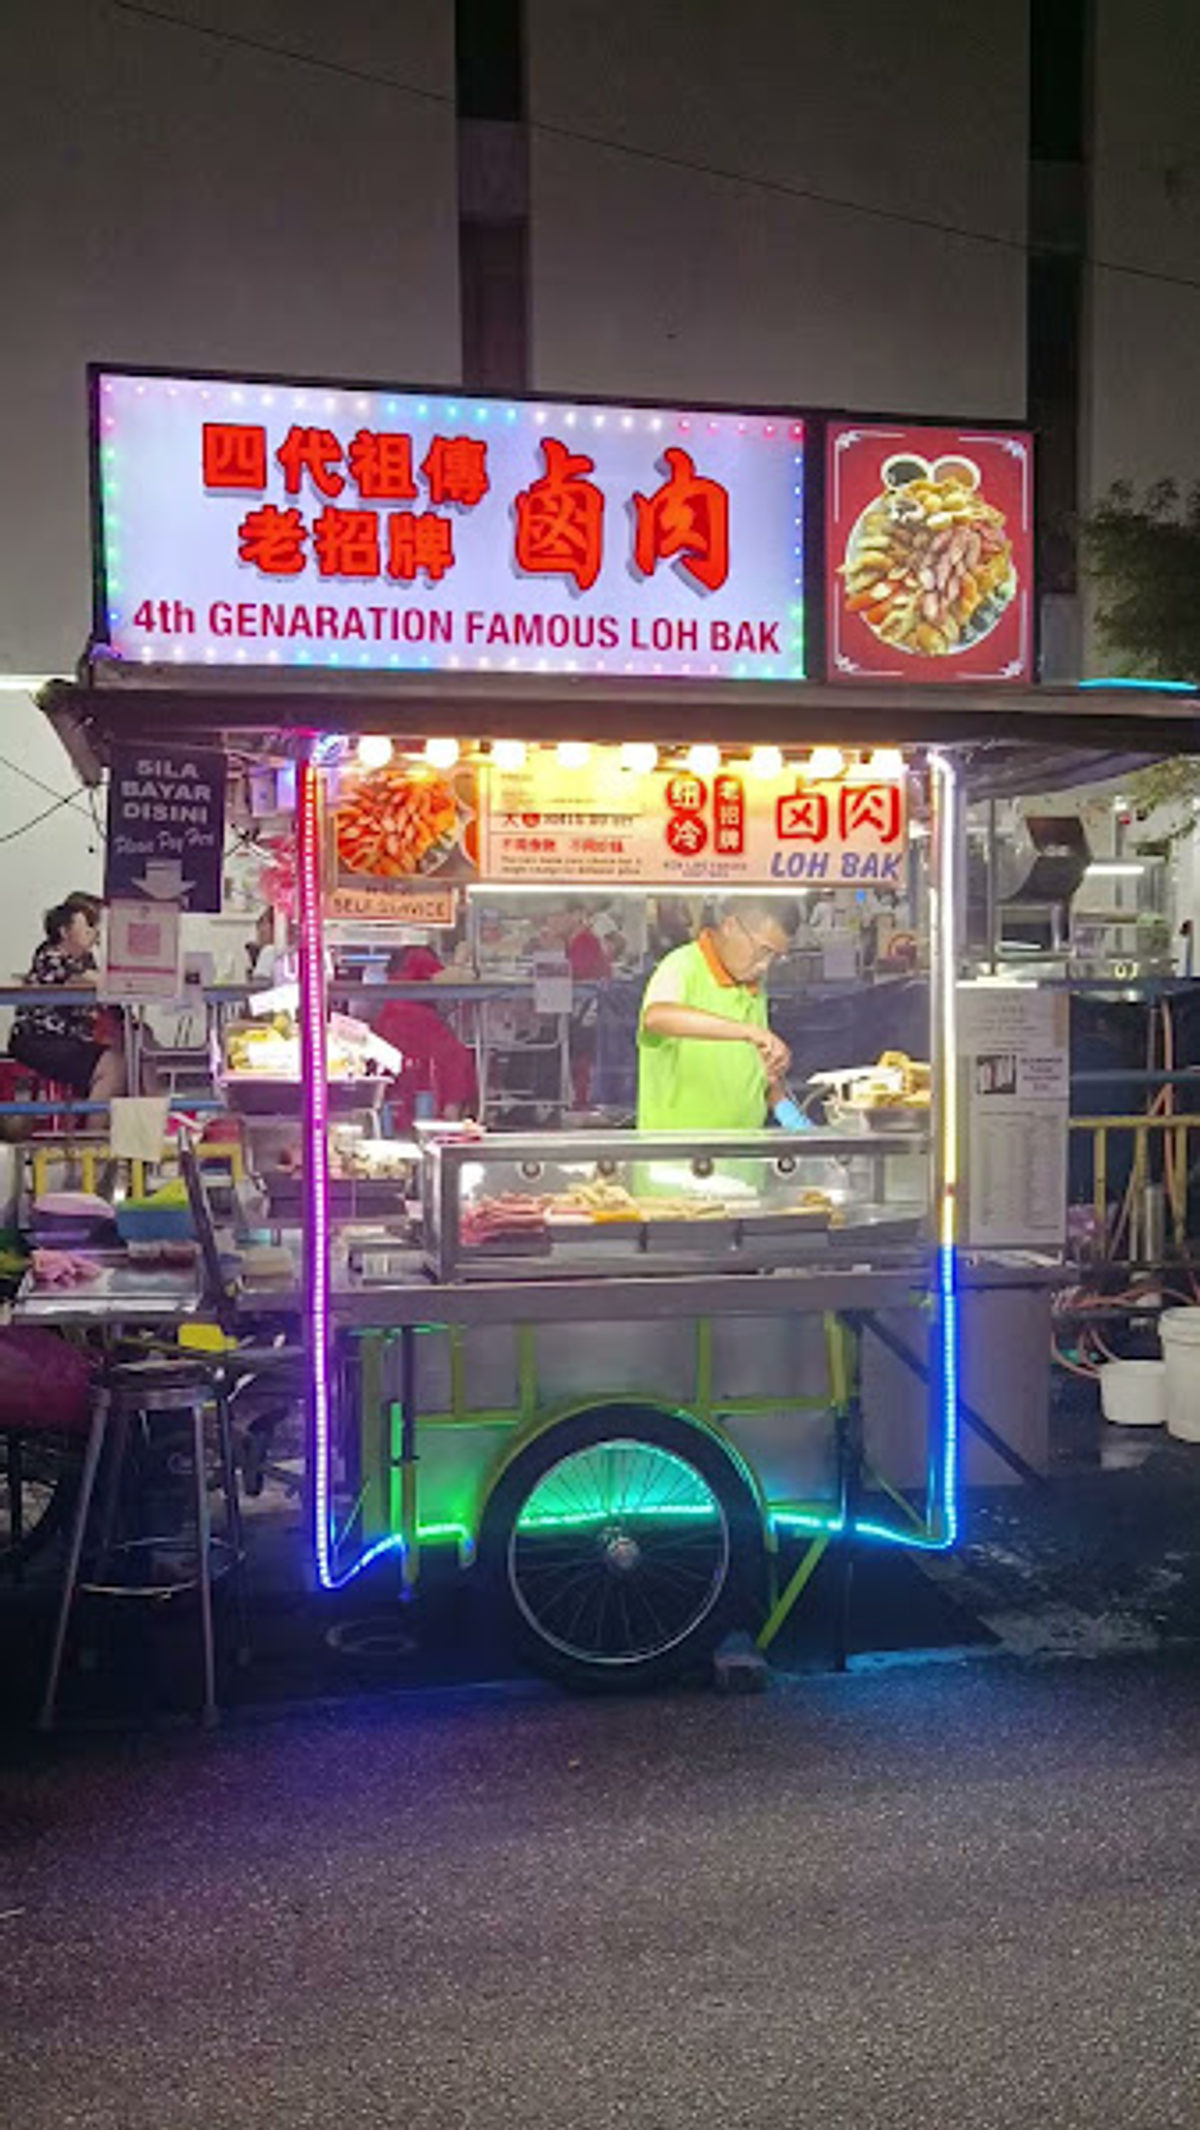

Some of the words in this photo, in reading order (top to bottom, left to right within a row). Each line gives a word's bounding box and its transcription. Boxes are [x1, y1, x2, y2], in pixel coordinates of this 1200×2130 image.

[202, 422, 490, 506] 四代祖傳
[238, 504, 455, 581] 老招牌
[133, 599, 195, 633] 4th
[209, 600, 453, 643] GENARATION
[465, 610, 619, 649] FAMOUS
[631, 616, 698, 652] LOH
[709, 621, 781, 653] BAK
[136, 759, 199, 779] SILA
[120, 780, 212, 801] BAYAR
[123, 803, 208, 824] DISINI
[770, 852, 829, 878] LOH
[841, 852, 902, 881] BAK
